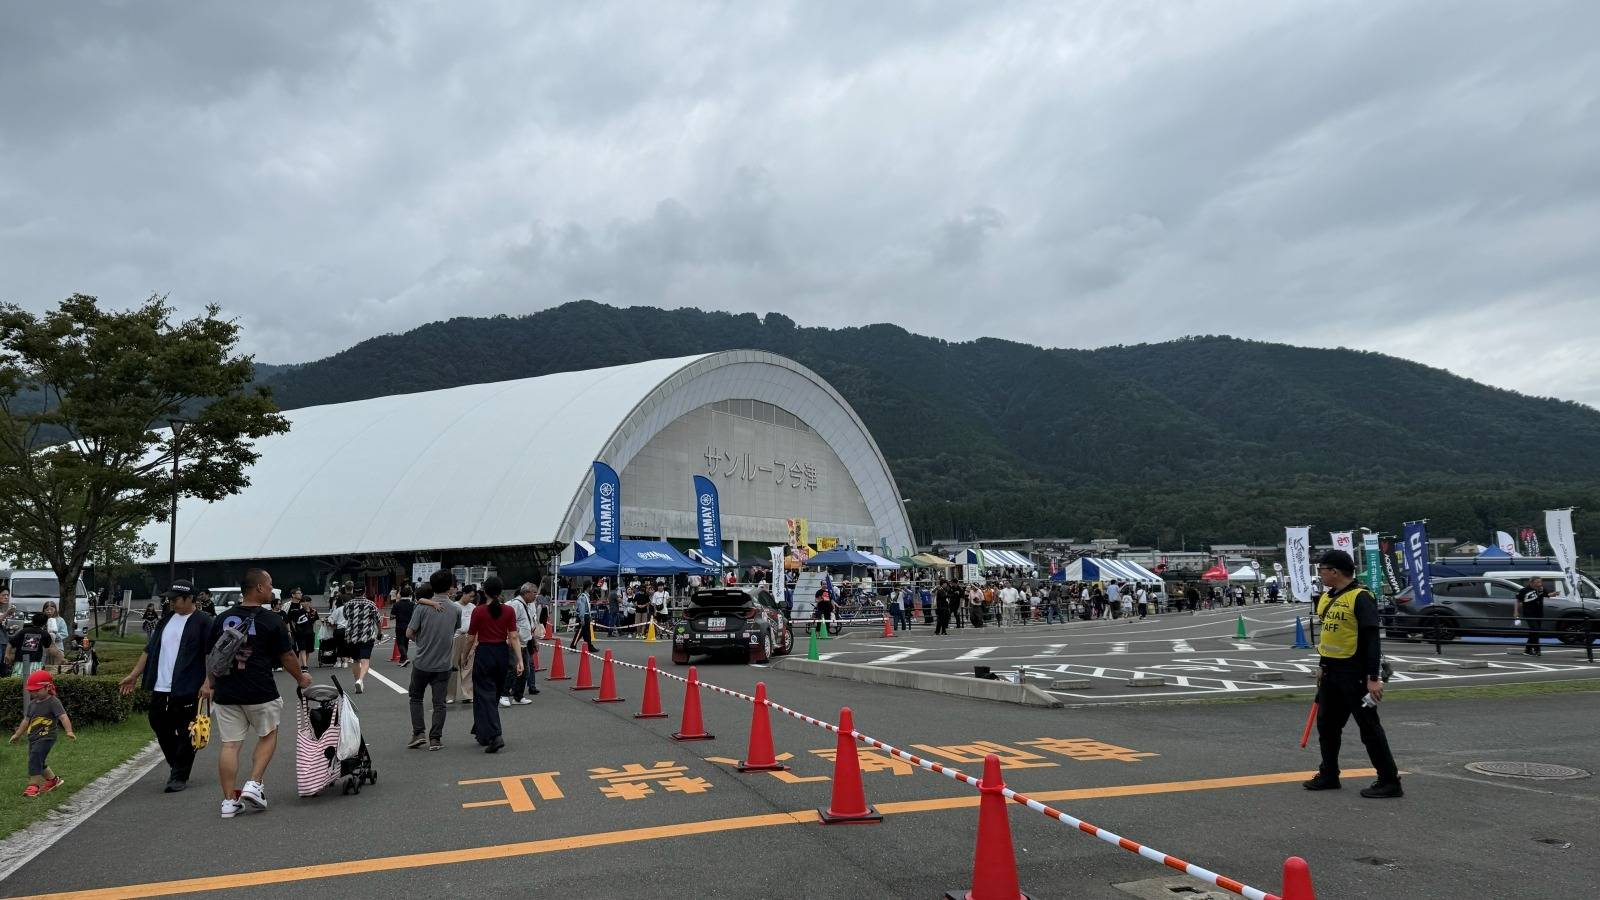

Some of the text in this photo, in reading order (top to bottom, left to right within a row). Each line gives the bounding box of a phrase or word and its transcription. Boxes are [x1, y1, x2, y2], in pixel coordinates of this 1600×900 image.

[703, 446, 817, 491] サンルーフ今津
